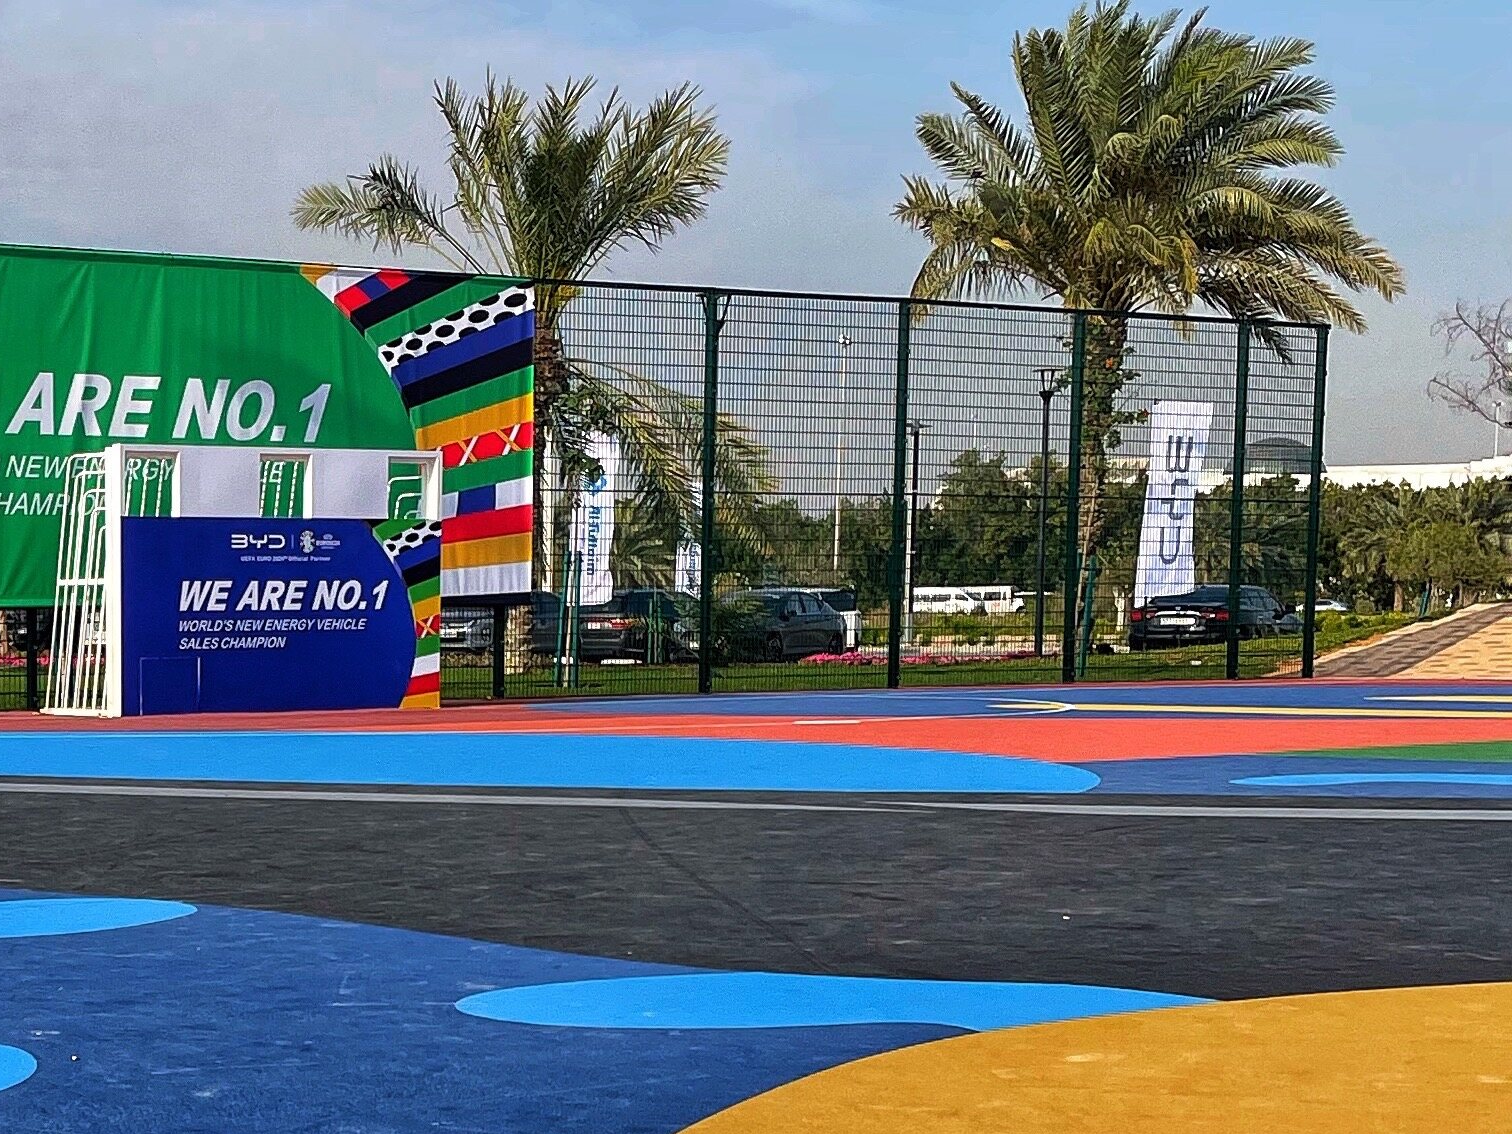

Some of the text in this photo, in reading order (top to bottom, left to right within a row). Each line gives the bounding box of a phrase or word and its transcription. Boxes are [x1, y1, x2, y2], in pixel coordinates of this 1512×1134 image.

[5, 371, 162, 438] ARE
[172, 376, 332, 443] NO.1
[5, 454, 68, 481] NEW
[71, 456, 173, 482] ENRGY
[1159, 434, 1193, 566] BYD
[231, 534, 286, 549] BYD
[179, 579, 389, 612] WE ARE NO.1
[179, 618, 368, 632] WORLD'S NEW ENERGY VEHICLE
[179, 636, 287, 650] SALES CHAMPION
